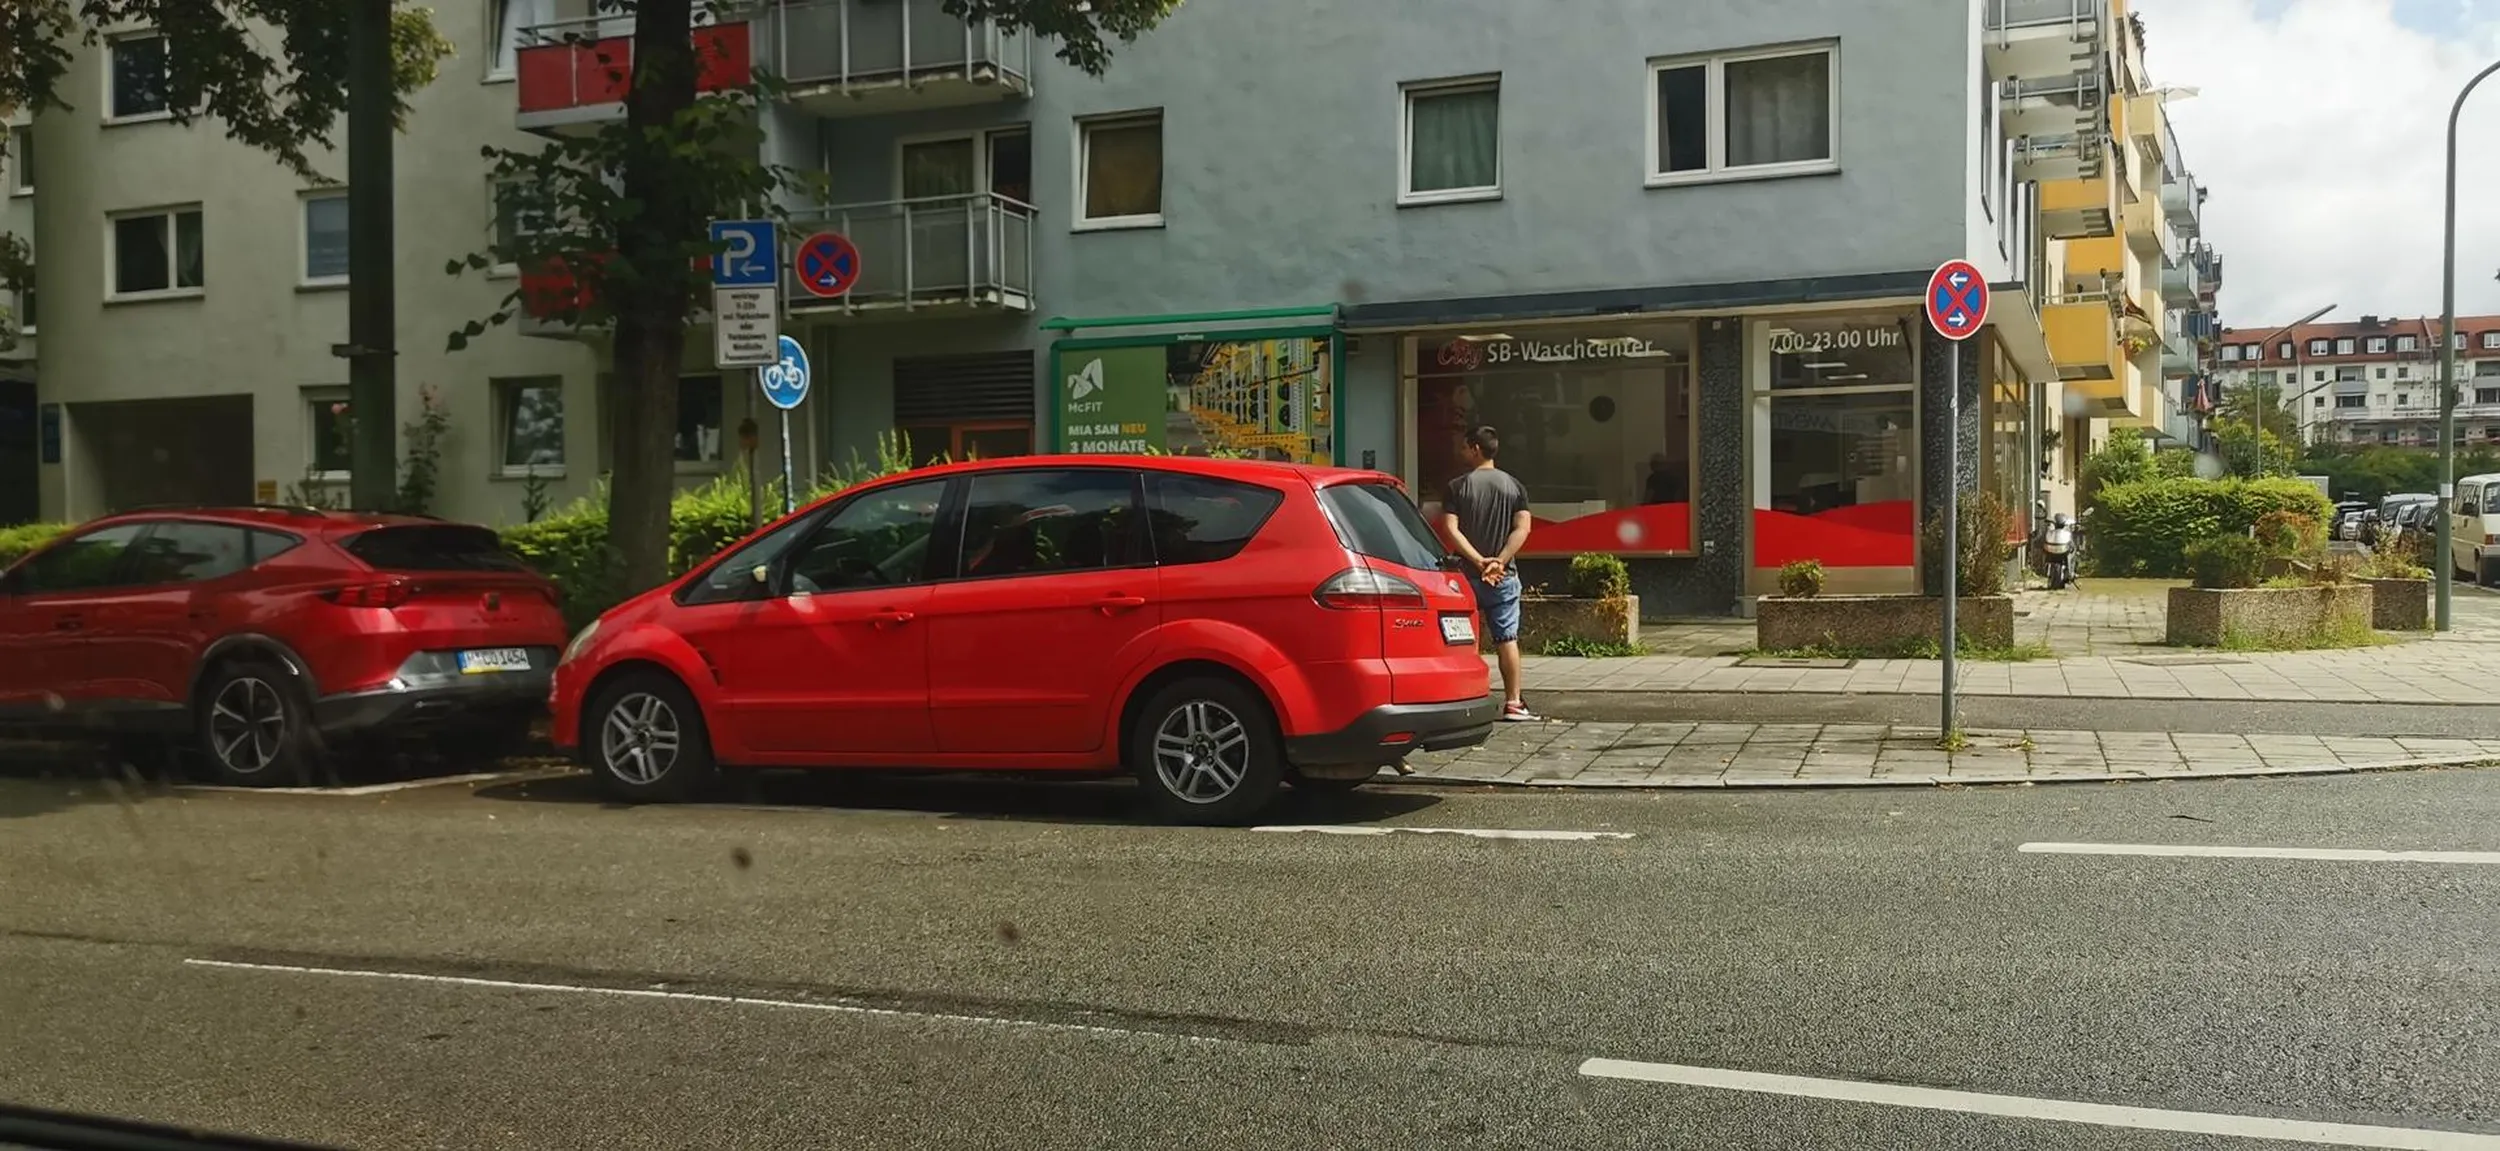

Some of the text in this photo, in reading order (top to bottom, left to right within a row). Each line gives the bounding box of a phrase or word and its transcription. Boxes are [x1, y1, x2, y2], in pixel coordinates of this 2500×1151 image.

[721, 229, 756, 278] P
[1867, 327, 1899, 347] Uhr
[1487, 337, 1653, 363] SB-Waschcenter
[1068, 401, 1103, 413] McFIT
[1068, 423, 1147, 436] MIA SAN NEU
[1070, 439, 1147, 454] 3 MONATE
